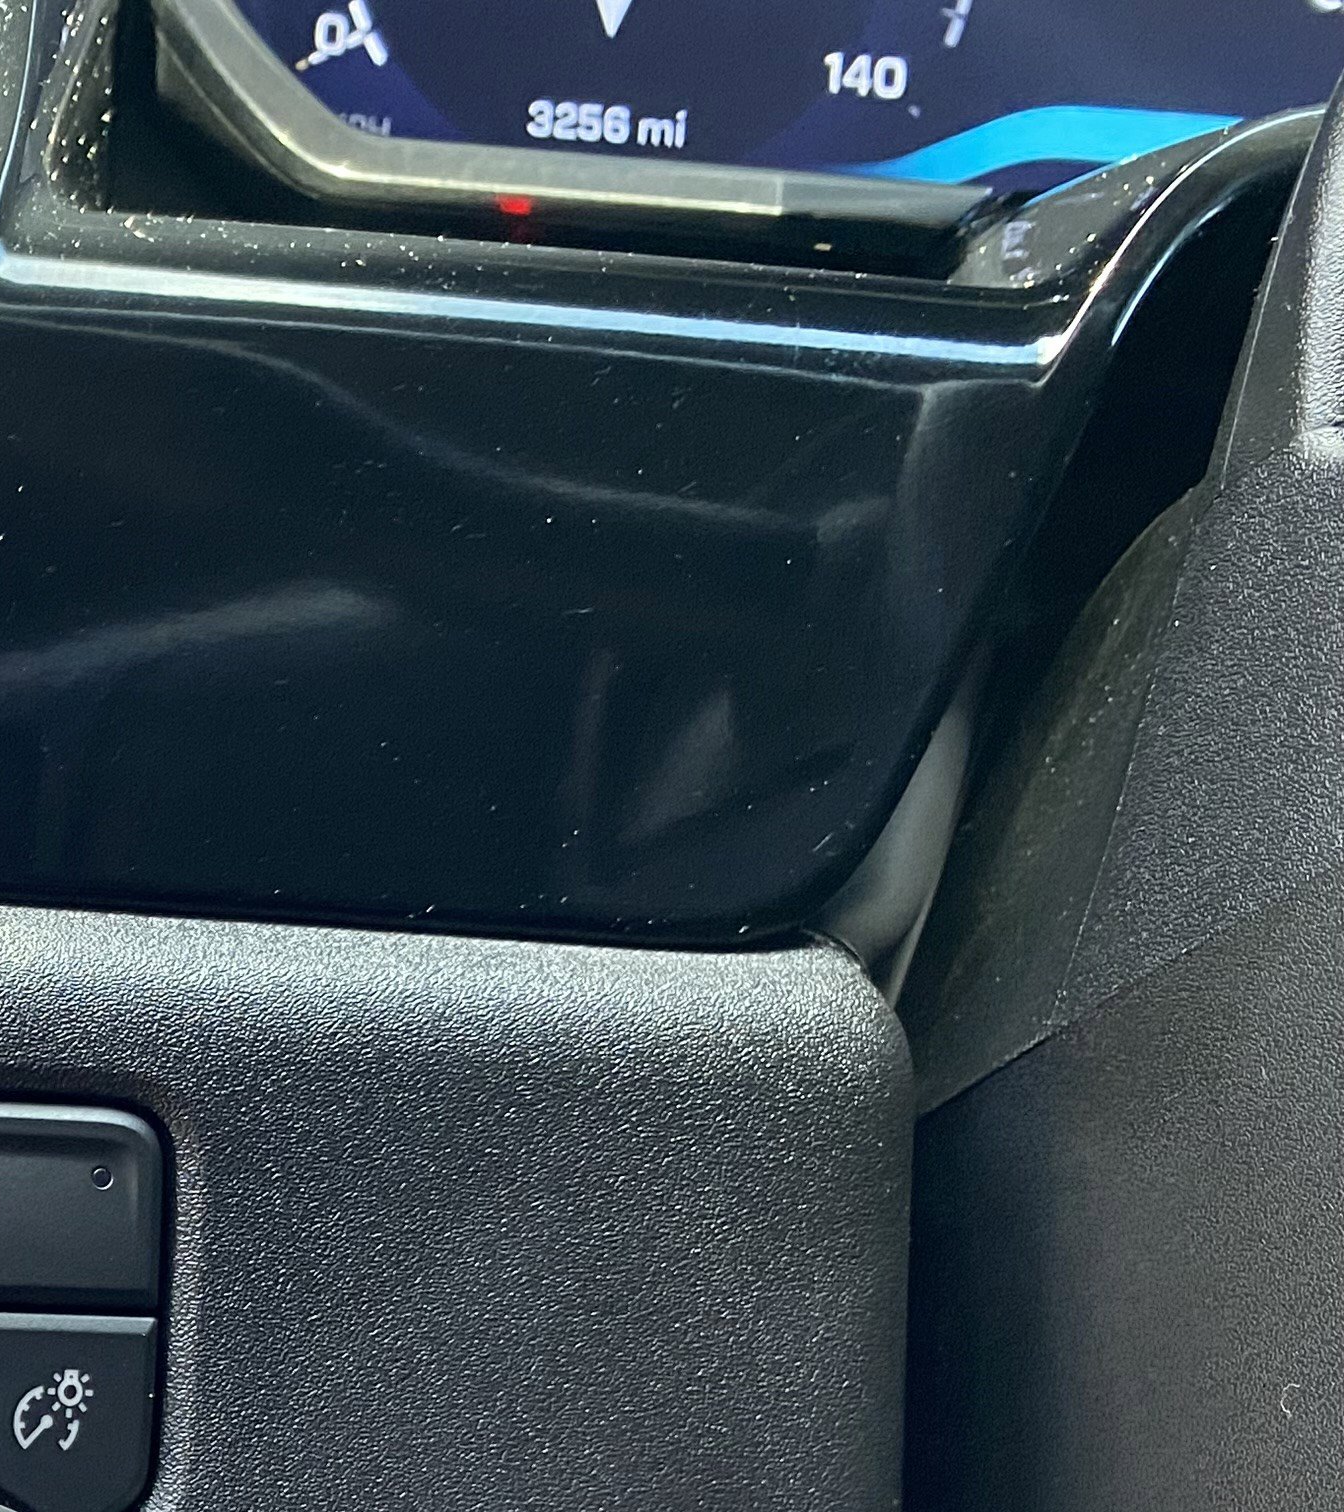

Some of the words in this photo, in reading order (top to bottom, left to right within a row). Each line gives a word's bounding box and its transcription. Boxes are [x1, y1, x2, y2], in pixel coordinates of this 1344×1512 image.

[314, 12, 350, 56] 0
[823, 51, 908, 100] 140
[526, 99, 631, 144] 3256
[636, 109, 688, 149] mi
